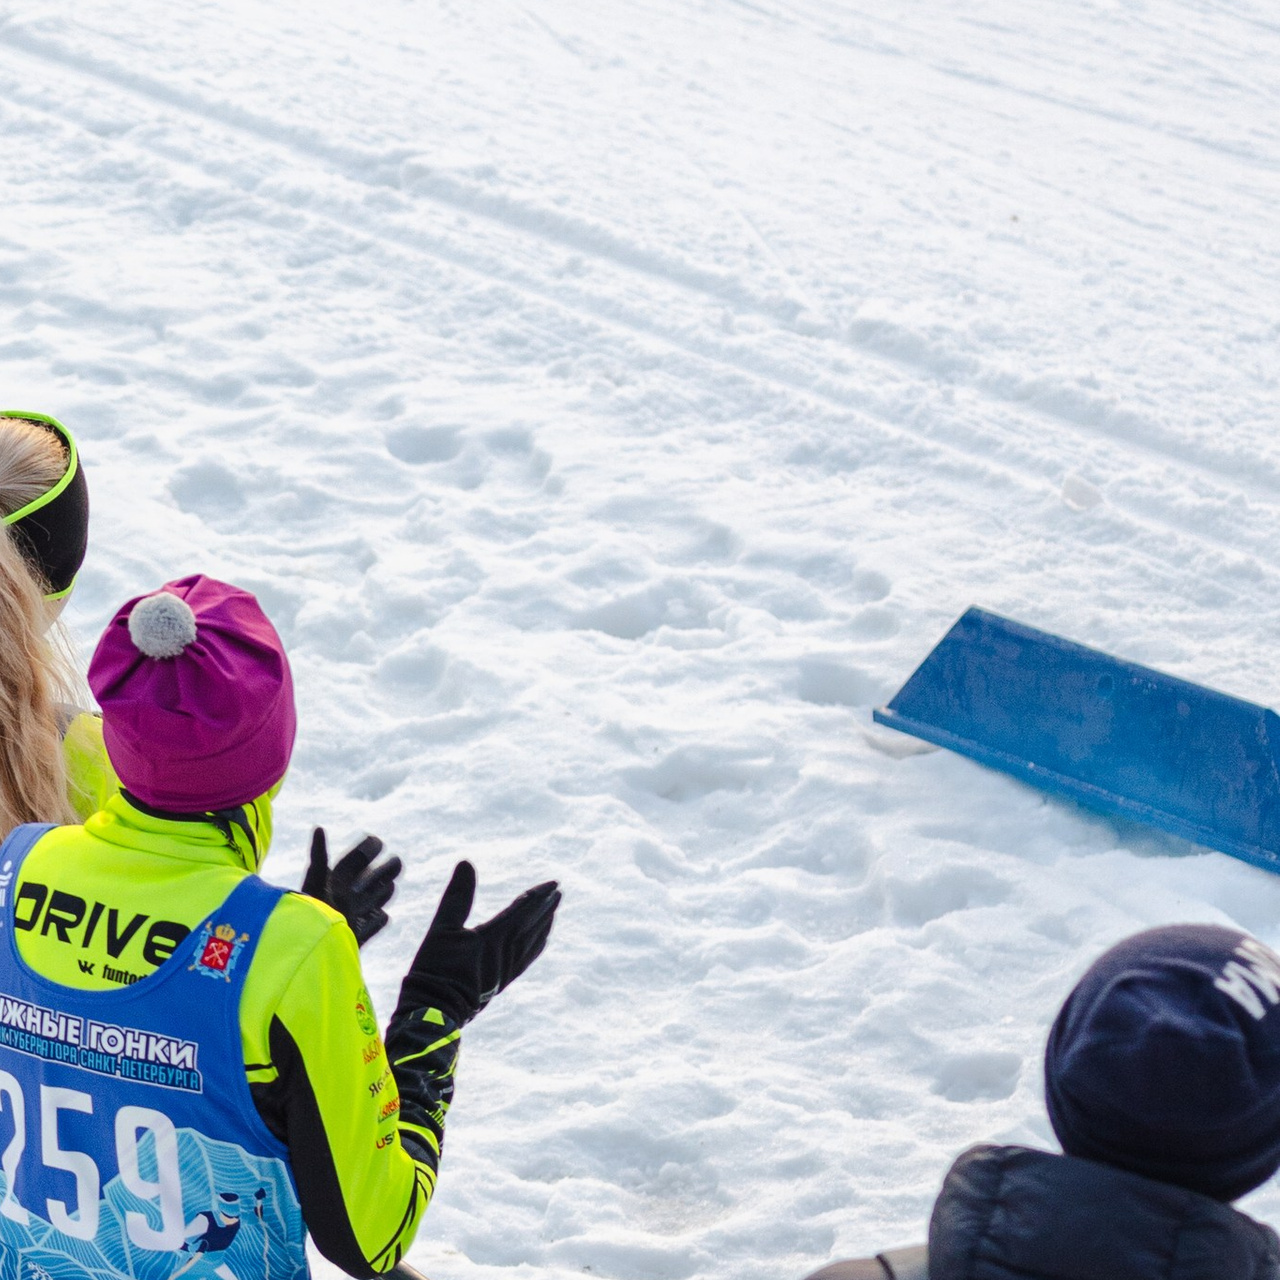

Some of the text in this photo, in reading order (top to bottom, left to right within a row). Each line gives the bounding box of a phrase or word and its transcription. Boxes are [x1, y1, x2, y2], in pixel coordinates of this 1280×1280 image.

[8, 1029, 78, 1063] ГУБЕРНАТОРА
[80, 1049, 199, 1091] САНКТ-ПЕТЕРБУРГА
[90, 1022, 195, 1069] ГОНКИ
